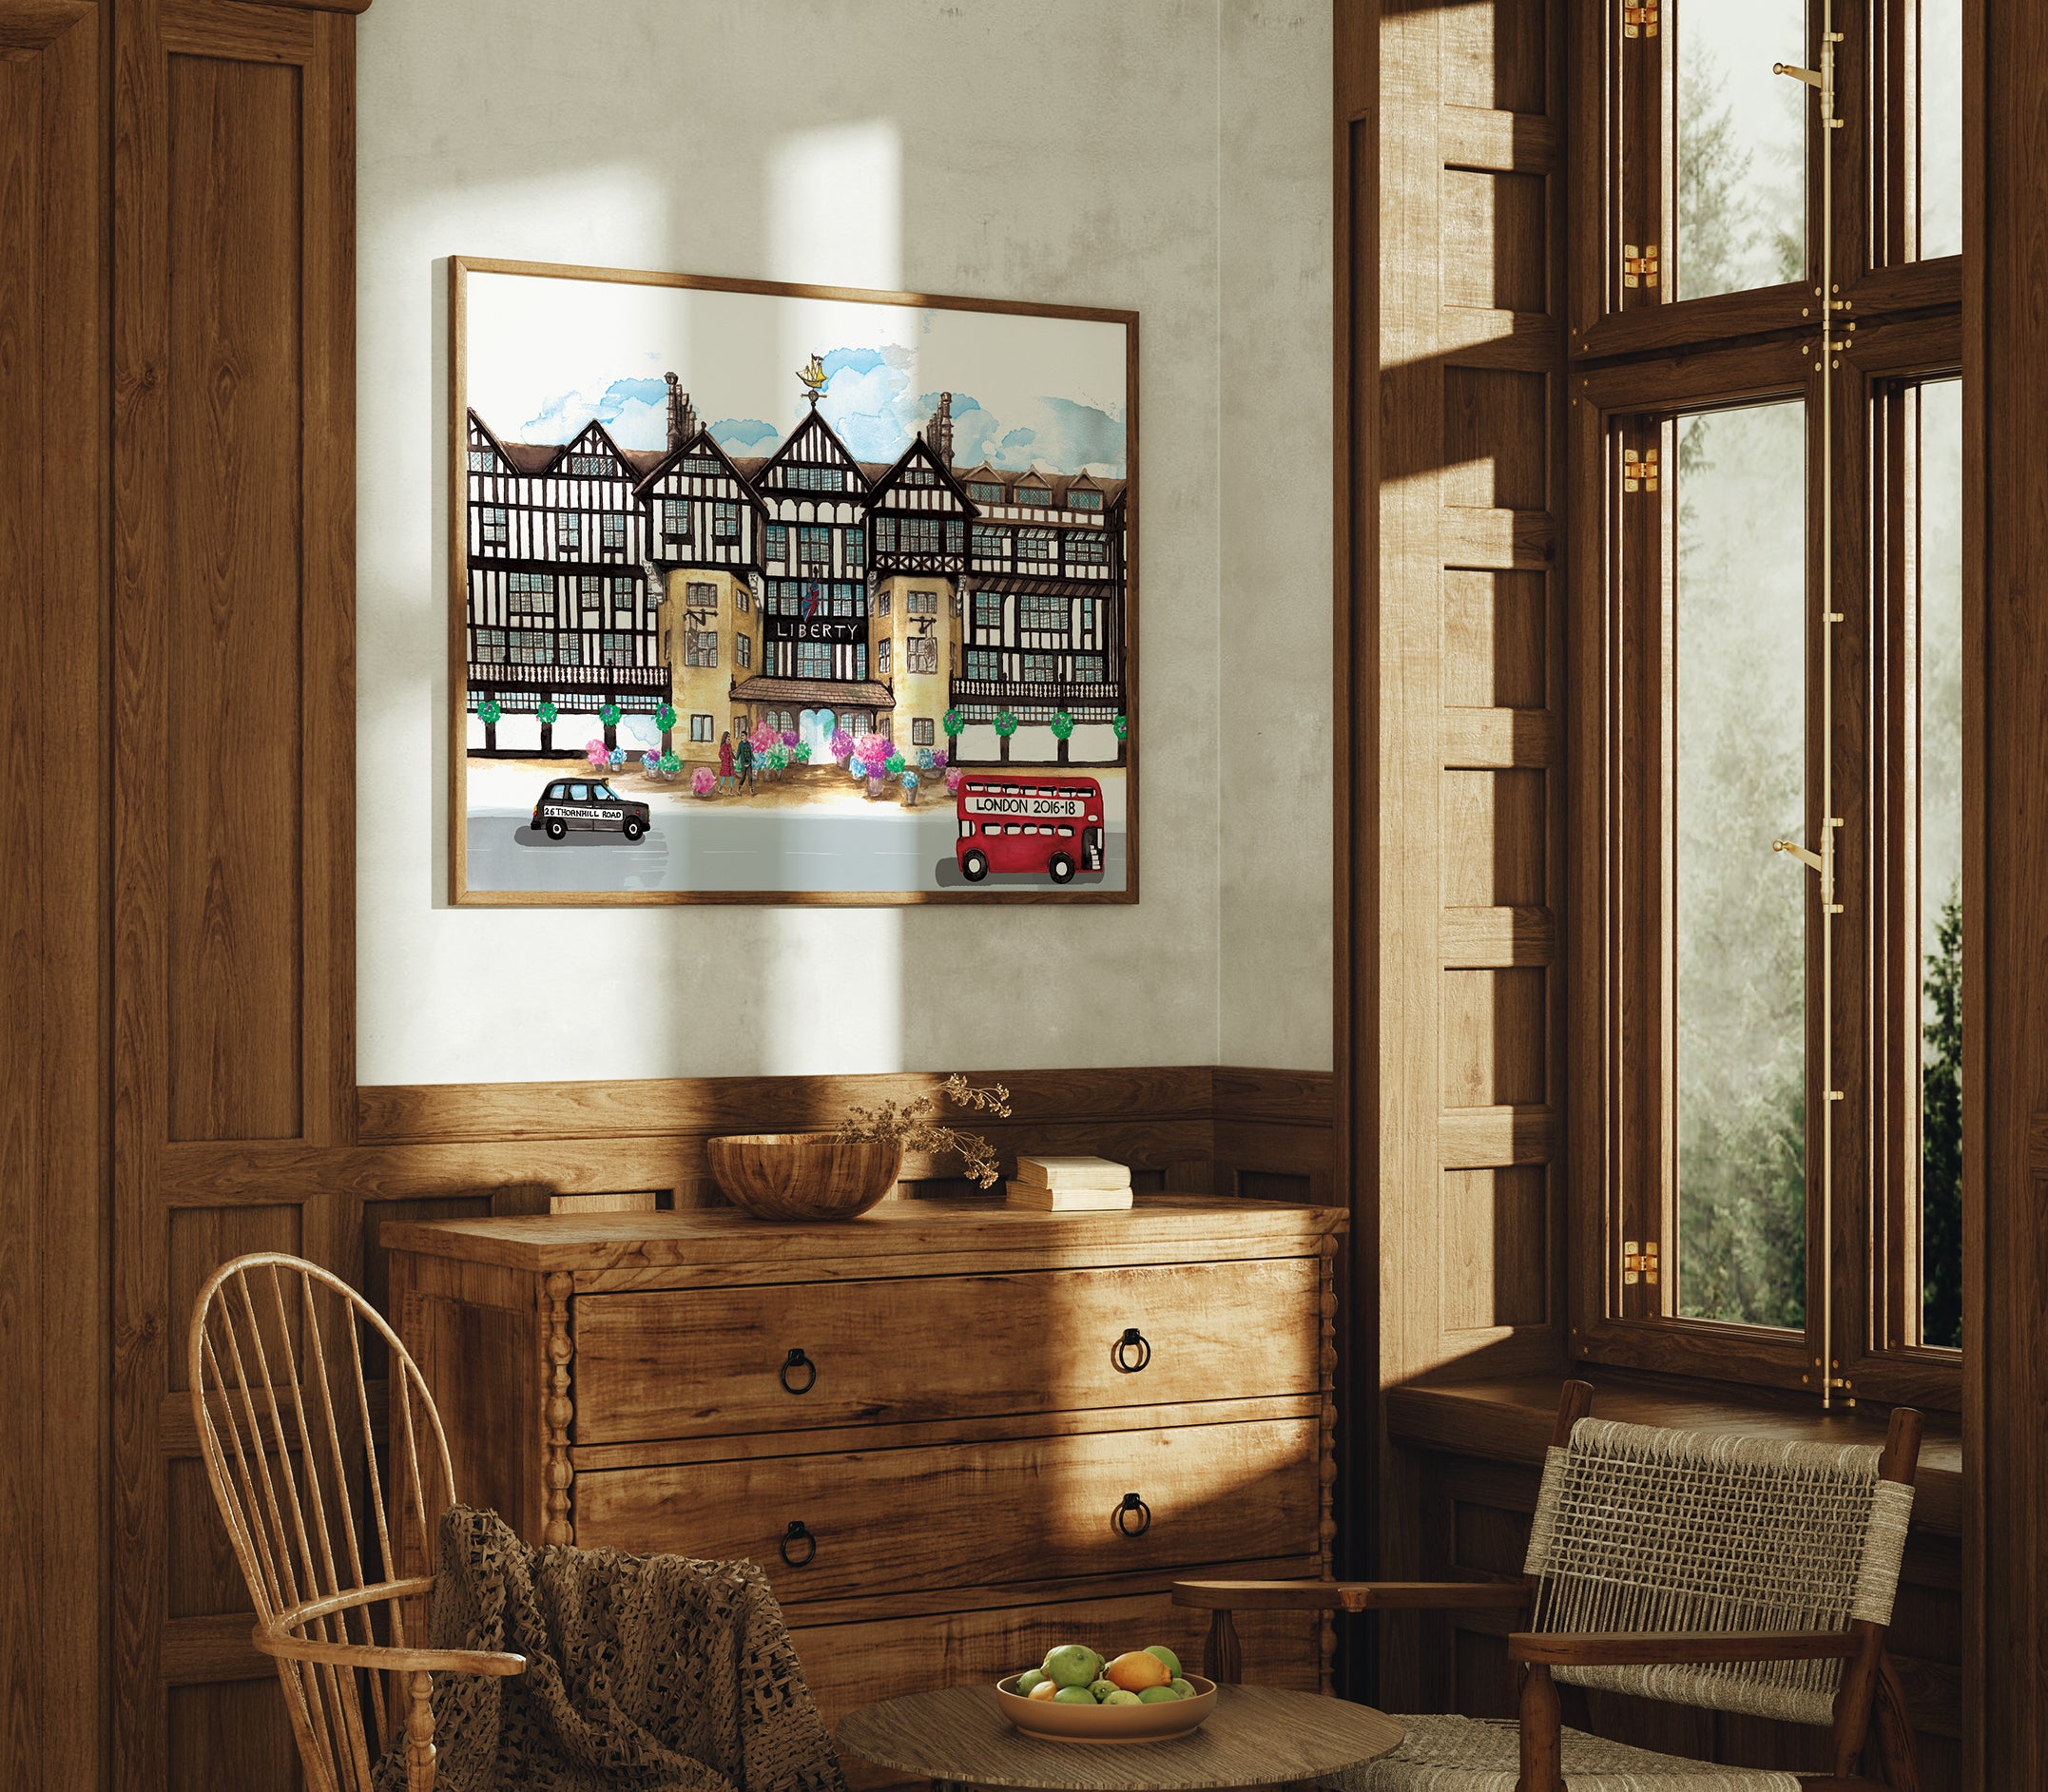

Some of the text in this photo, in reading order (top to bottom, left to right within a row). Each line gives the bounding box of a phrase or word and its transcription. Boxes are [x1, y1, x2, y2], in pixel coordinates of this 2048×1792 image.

[777, 623, 858, 640] LIBERTY
[556, 808, 599, 818] THORNHILL
[976, 799, 1075, 815] LONDON 2016-18
